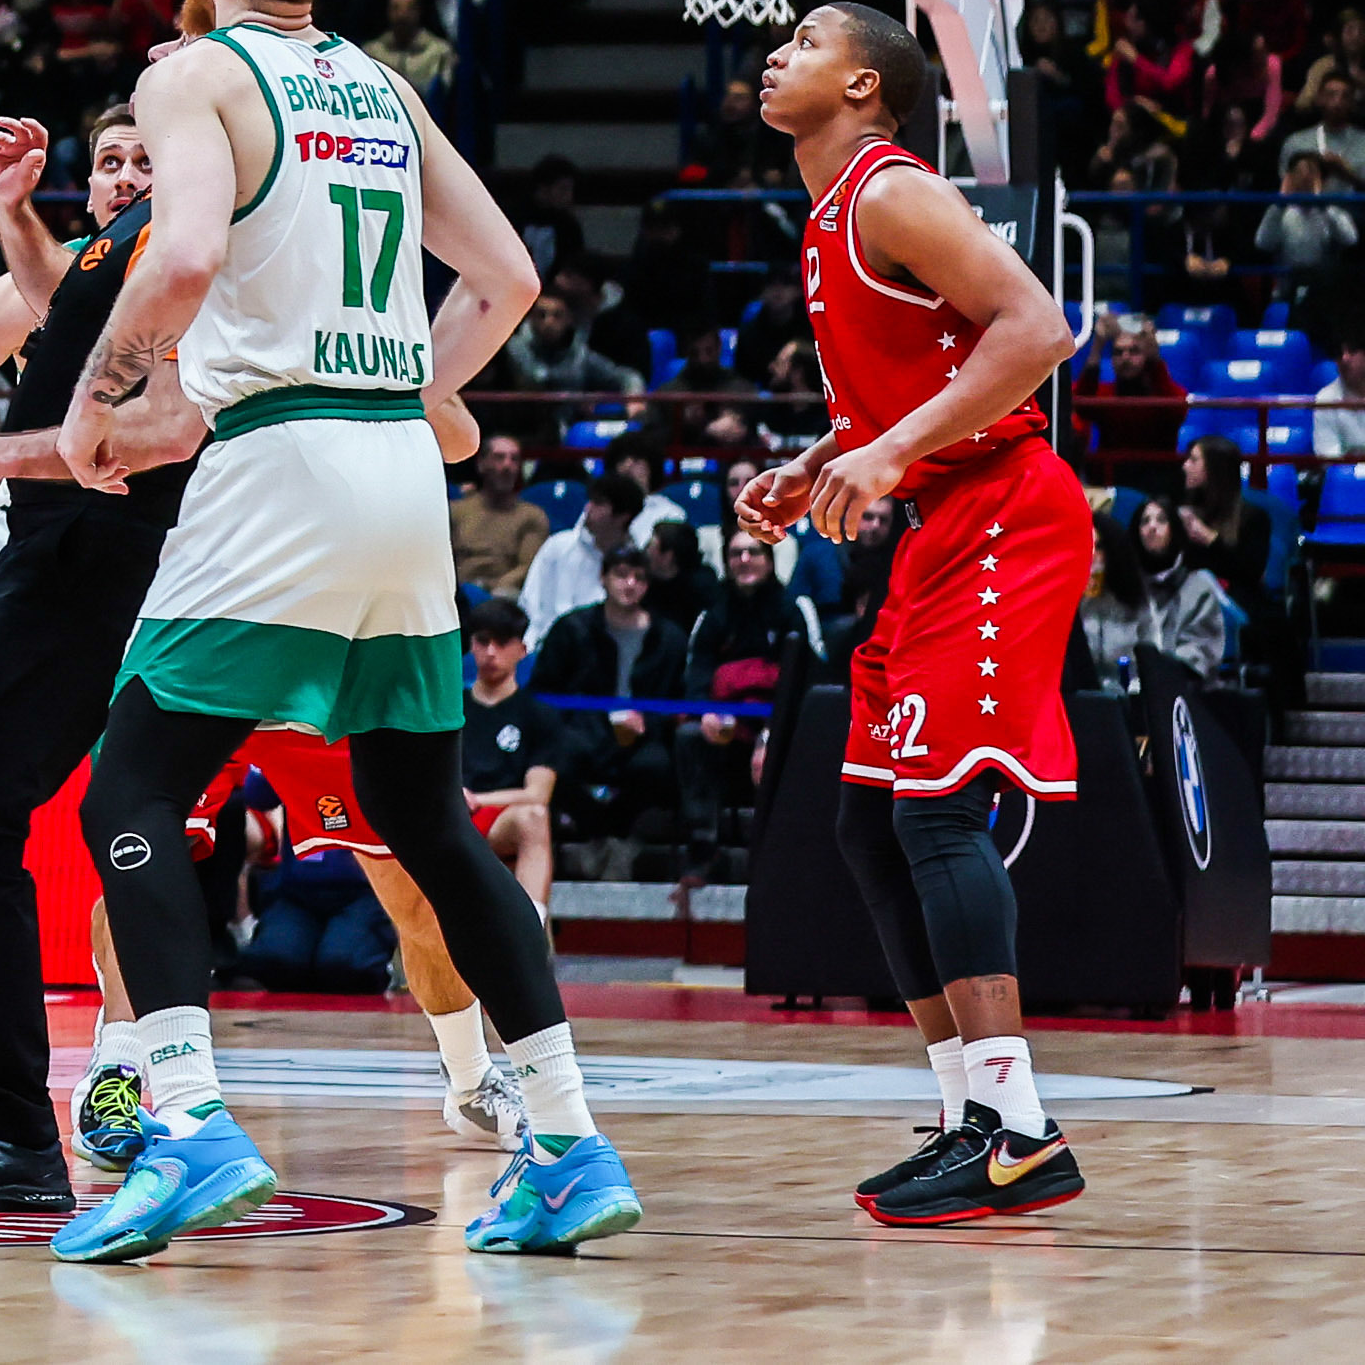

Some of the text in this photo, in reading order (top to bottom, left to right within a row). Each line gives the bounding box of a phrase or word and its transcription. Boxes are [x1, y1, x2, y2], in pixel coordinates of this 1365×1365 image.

[329, 183, 405, 314] 17
[314, 331, 425, 386] KAUNAS
[150, 1041, 198, 1066] GSA
